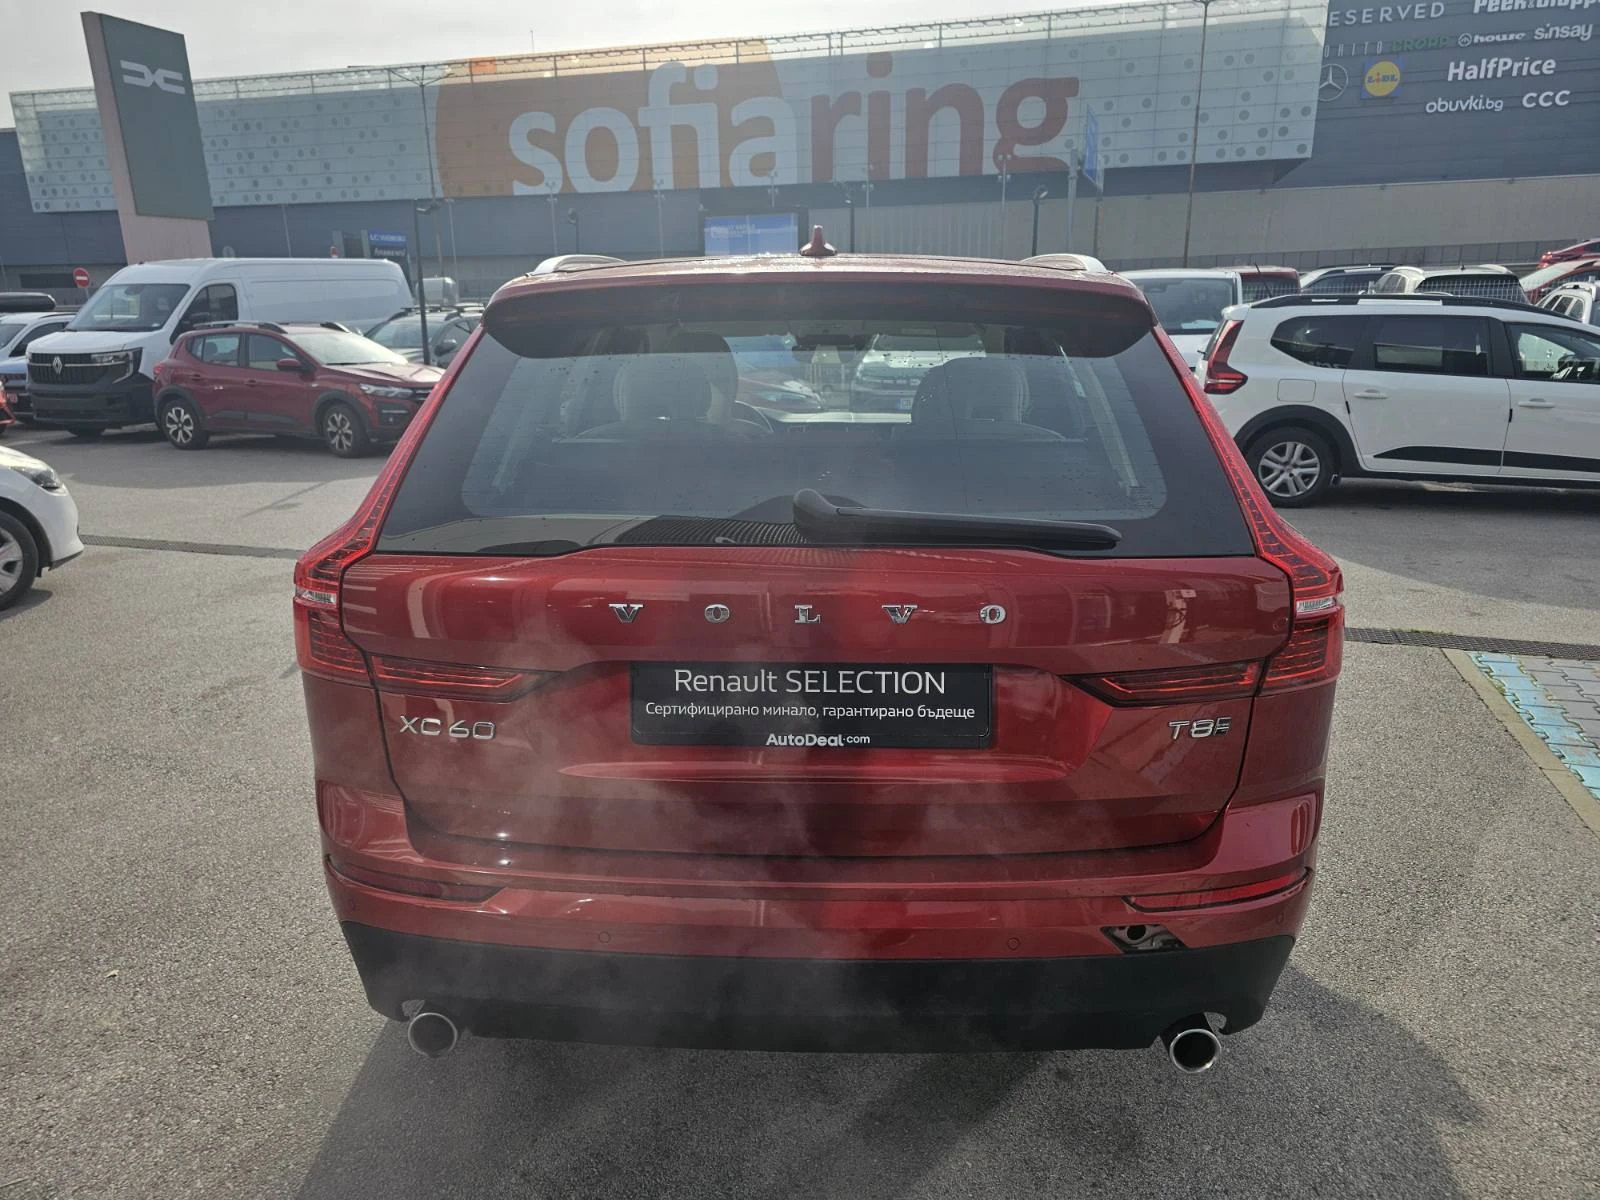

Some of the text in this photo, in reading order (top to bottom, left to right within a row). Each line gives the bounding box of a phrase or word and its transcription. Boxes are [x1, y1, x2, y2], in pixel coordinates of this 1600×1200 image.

[1328, 2, 1445, 27] ESERVED
[1533, 23, 1593, 41] sinsay
[1323, 40, 1383, 58] OHITO
[1447, 57, 1557, 81] HalfPrice
[1425, 94, 1504, 113] obuvki.bg
[1521, 90, 1571, 108] CCC
[508, 50, 1080, 196] sofiaring
[608, 603, 1007, 625] VOLVO
[674, 668, 945, 695] Renault SELECTION
[645, 702, 975, 720] Сертифицирано минало, гарантирано бъдеще
